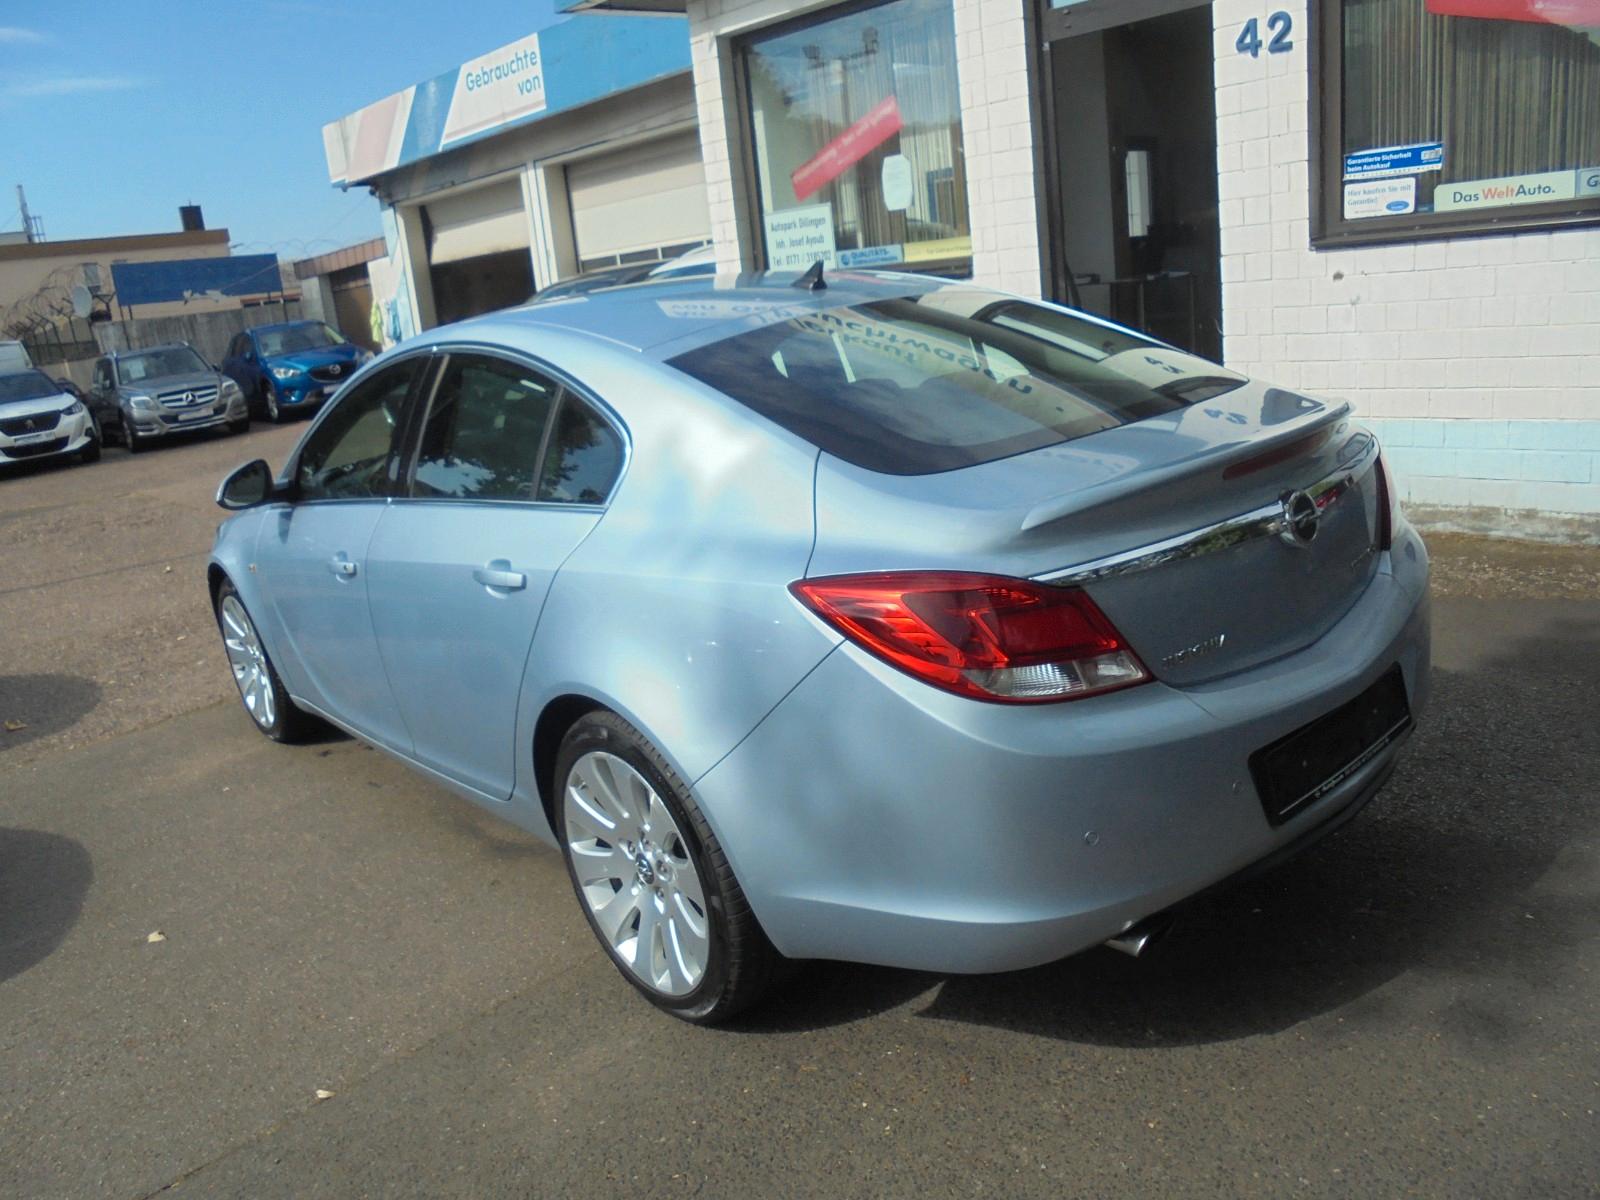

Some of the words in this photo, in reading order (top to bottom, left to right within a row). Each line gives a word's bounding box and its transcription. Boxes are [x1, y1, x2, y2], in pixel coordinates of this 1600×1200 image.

[1235, 10, 1293, 58] 42
[465, 49, 537, 92] Gebrauchte
[517, 75, 540, 96] von
[1347, 154, 1381, 166] Garantierte
[1382, 151, 1412, 161] Sicherheit
[1363, 161, 1391, 171] Autokauf
[1453, 191, 1480, 203] Das
[771, 221, 796, 232] Autopark
